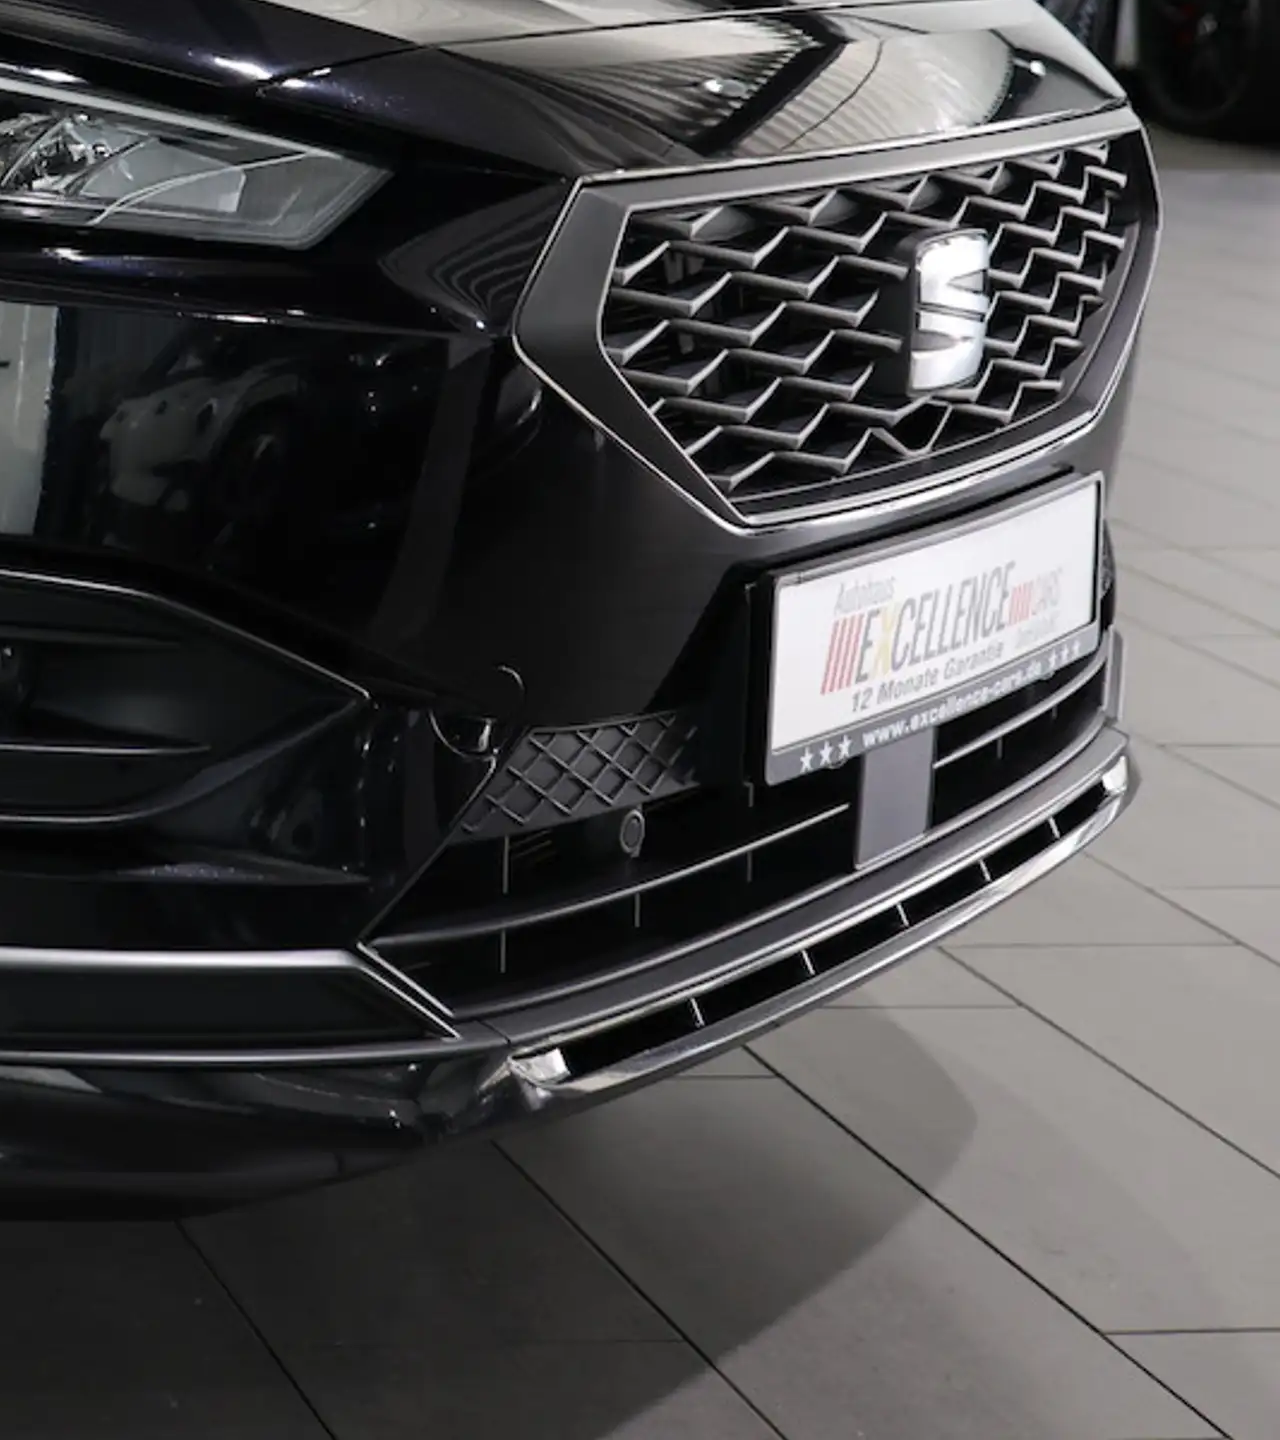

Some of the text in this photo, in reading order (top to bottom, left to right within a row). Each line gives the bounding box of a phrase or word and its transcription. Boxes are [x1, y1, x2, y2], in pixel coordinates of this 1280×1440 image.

[853, 560, 1016, 685] EXCELLENCE
[851, 687, 874, 712] 12
[877, 667, 939, 705] Monate
